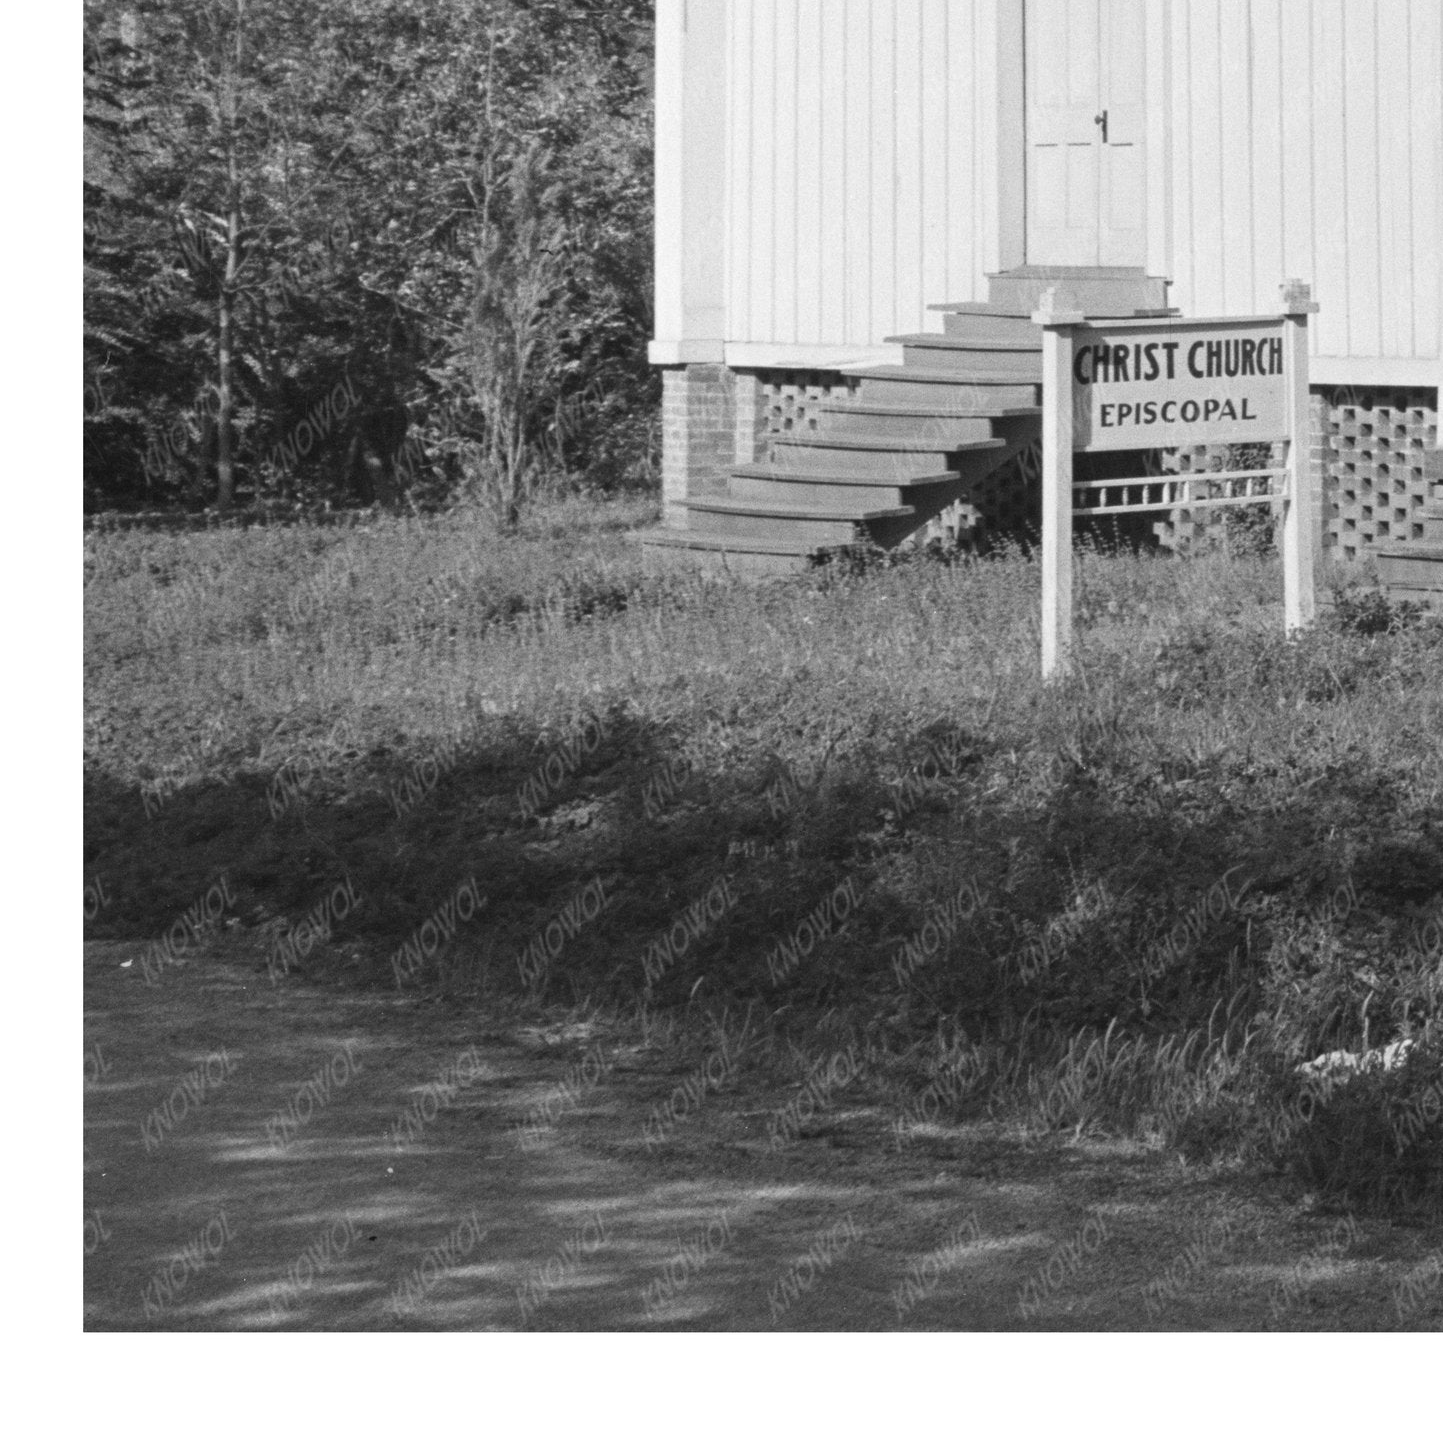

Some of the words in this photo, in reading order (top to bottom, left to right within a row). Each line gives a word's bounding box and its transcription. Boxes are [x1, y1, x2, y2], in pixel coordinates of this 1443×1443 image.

[1072, 342, 1180, 386] CHRIST
[1187, 337, 1283, 379] CHURCH
[1100, 397, 1258, 428] EPISCOPAL
